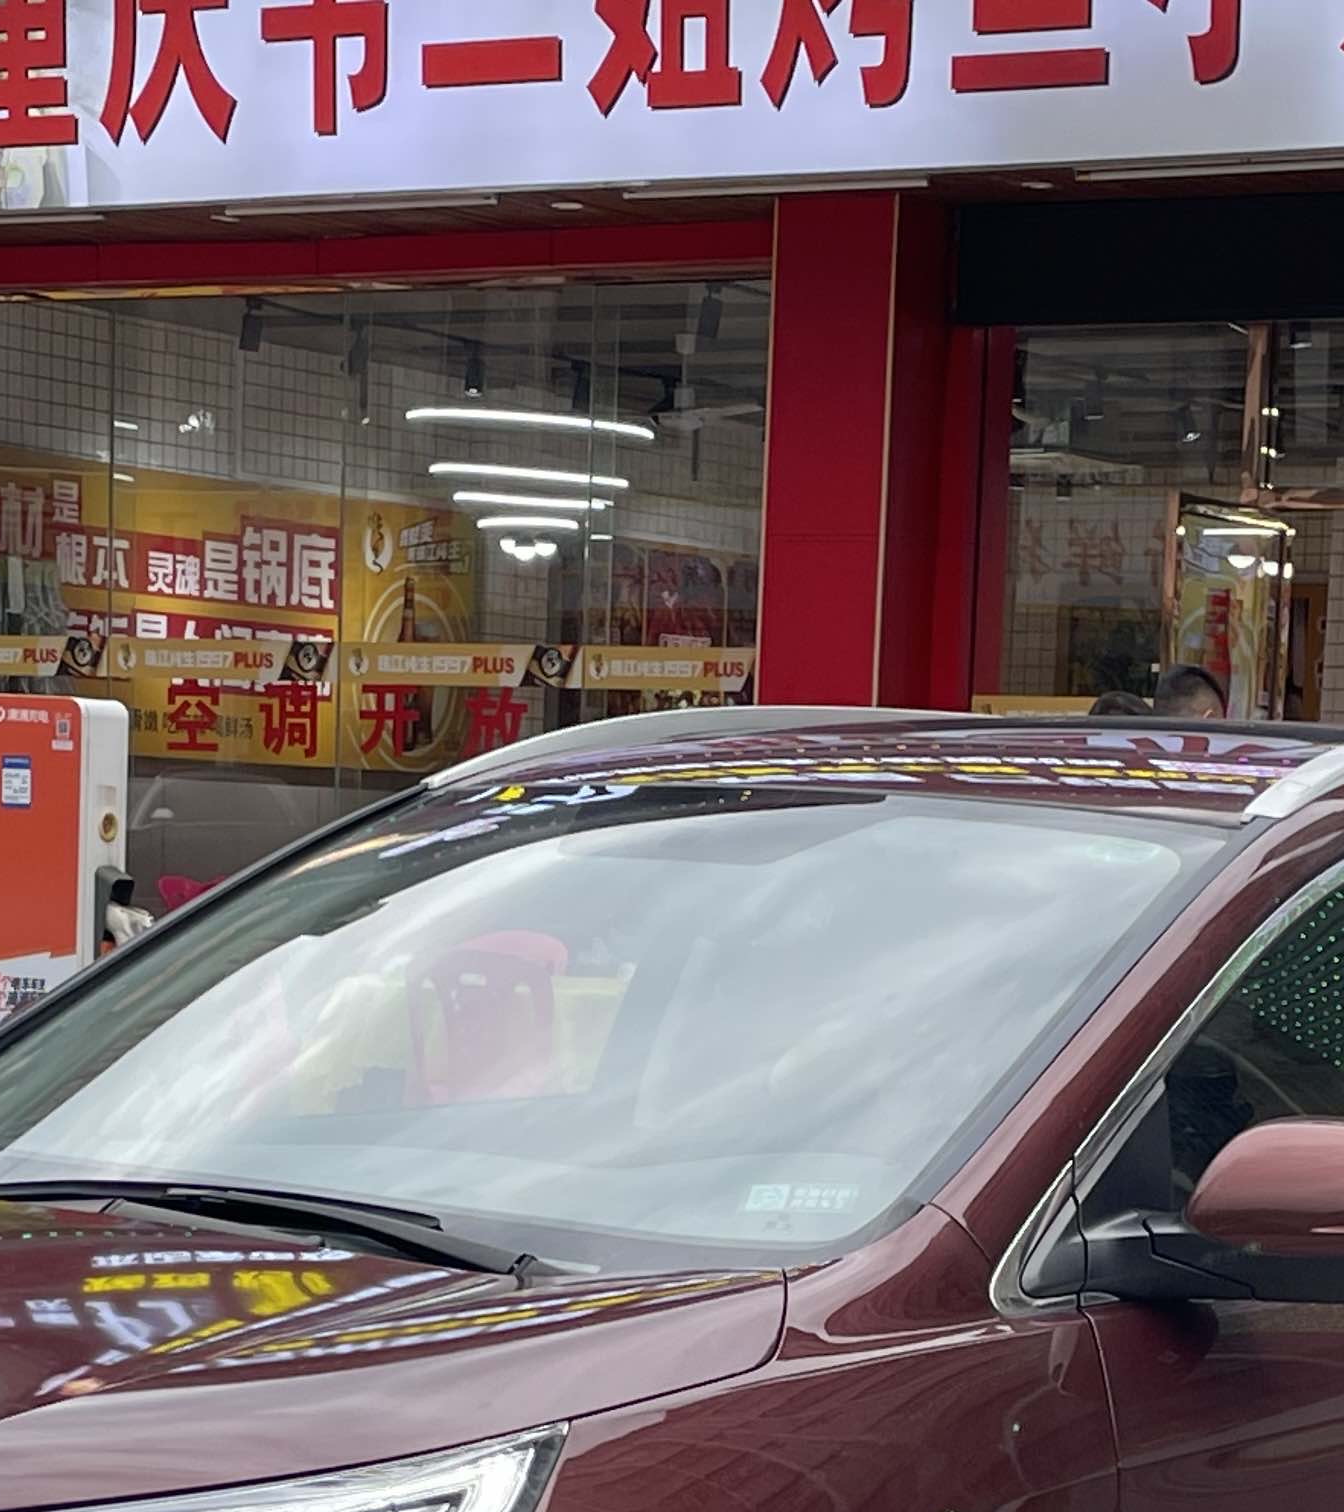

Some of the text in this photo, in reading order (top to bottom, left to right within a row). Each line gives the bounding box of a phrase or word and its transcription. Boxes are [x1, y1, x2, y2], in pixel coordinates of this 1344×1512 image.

[147, 525, 338, 609] 灵魂是锅底
[166, 680, 529, 759] 空调开放
